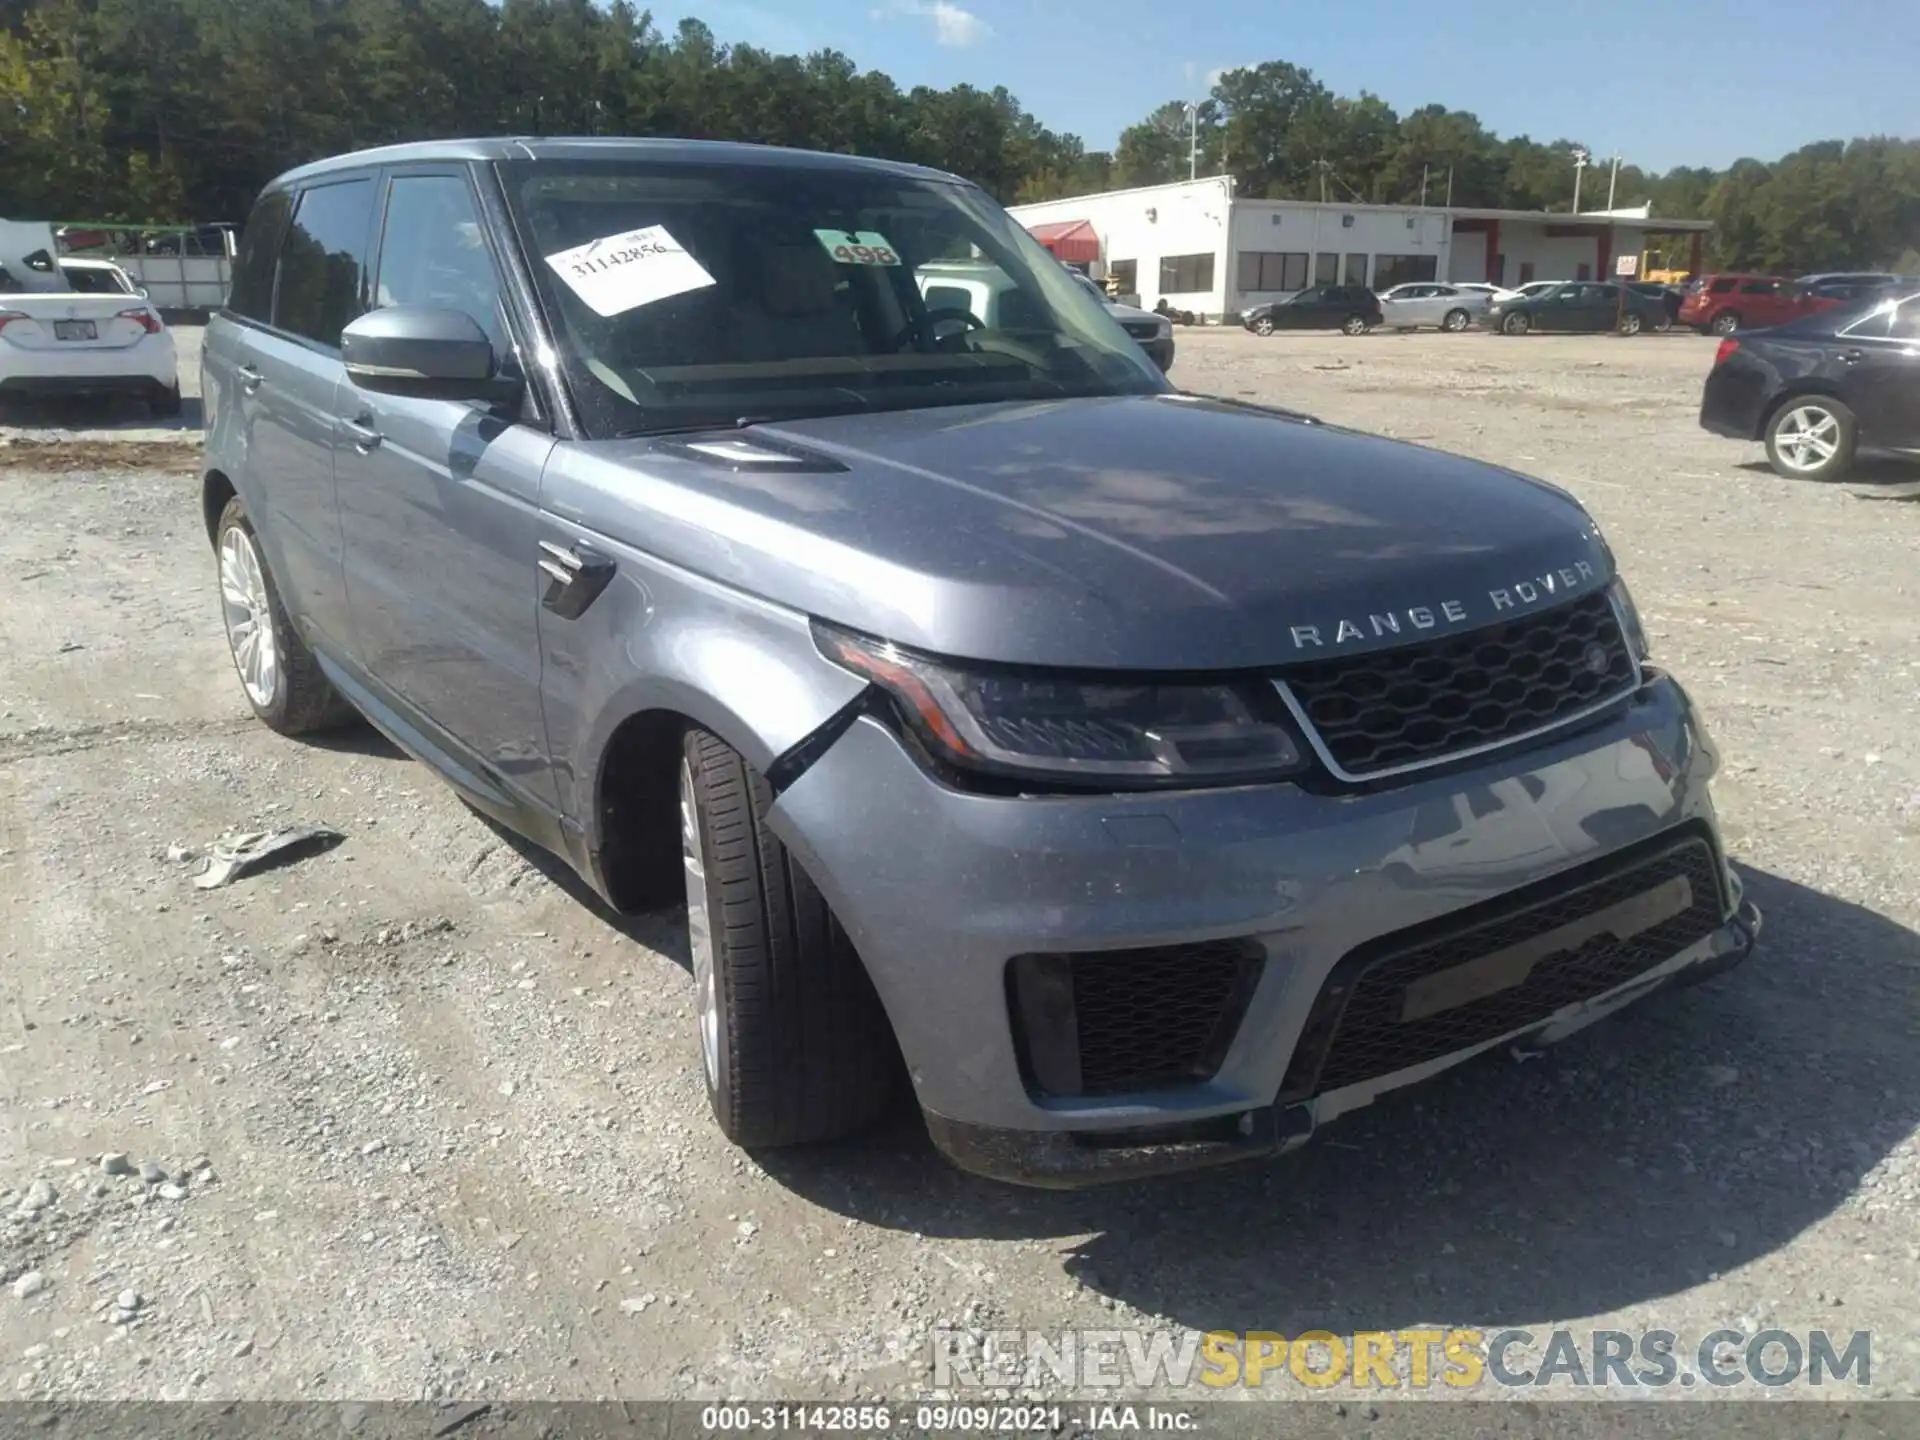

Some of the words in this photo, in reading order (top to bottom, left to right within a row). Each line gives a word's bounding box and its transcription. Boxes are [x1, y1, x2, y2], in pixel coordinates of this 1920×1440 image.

[572, 241, 667, 278] 31142856
[1290, 600, 1467, 648] RANGE
[1489, 560, 1594, 611] ROVER
